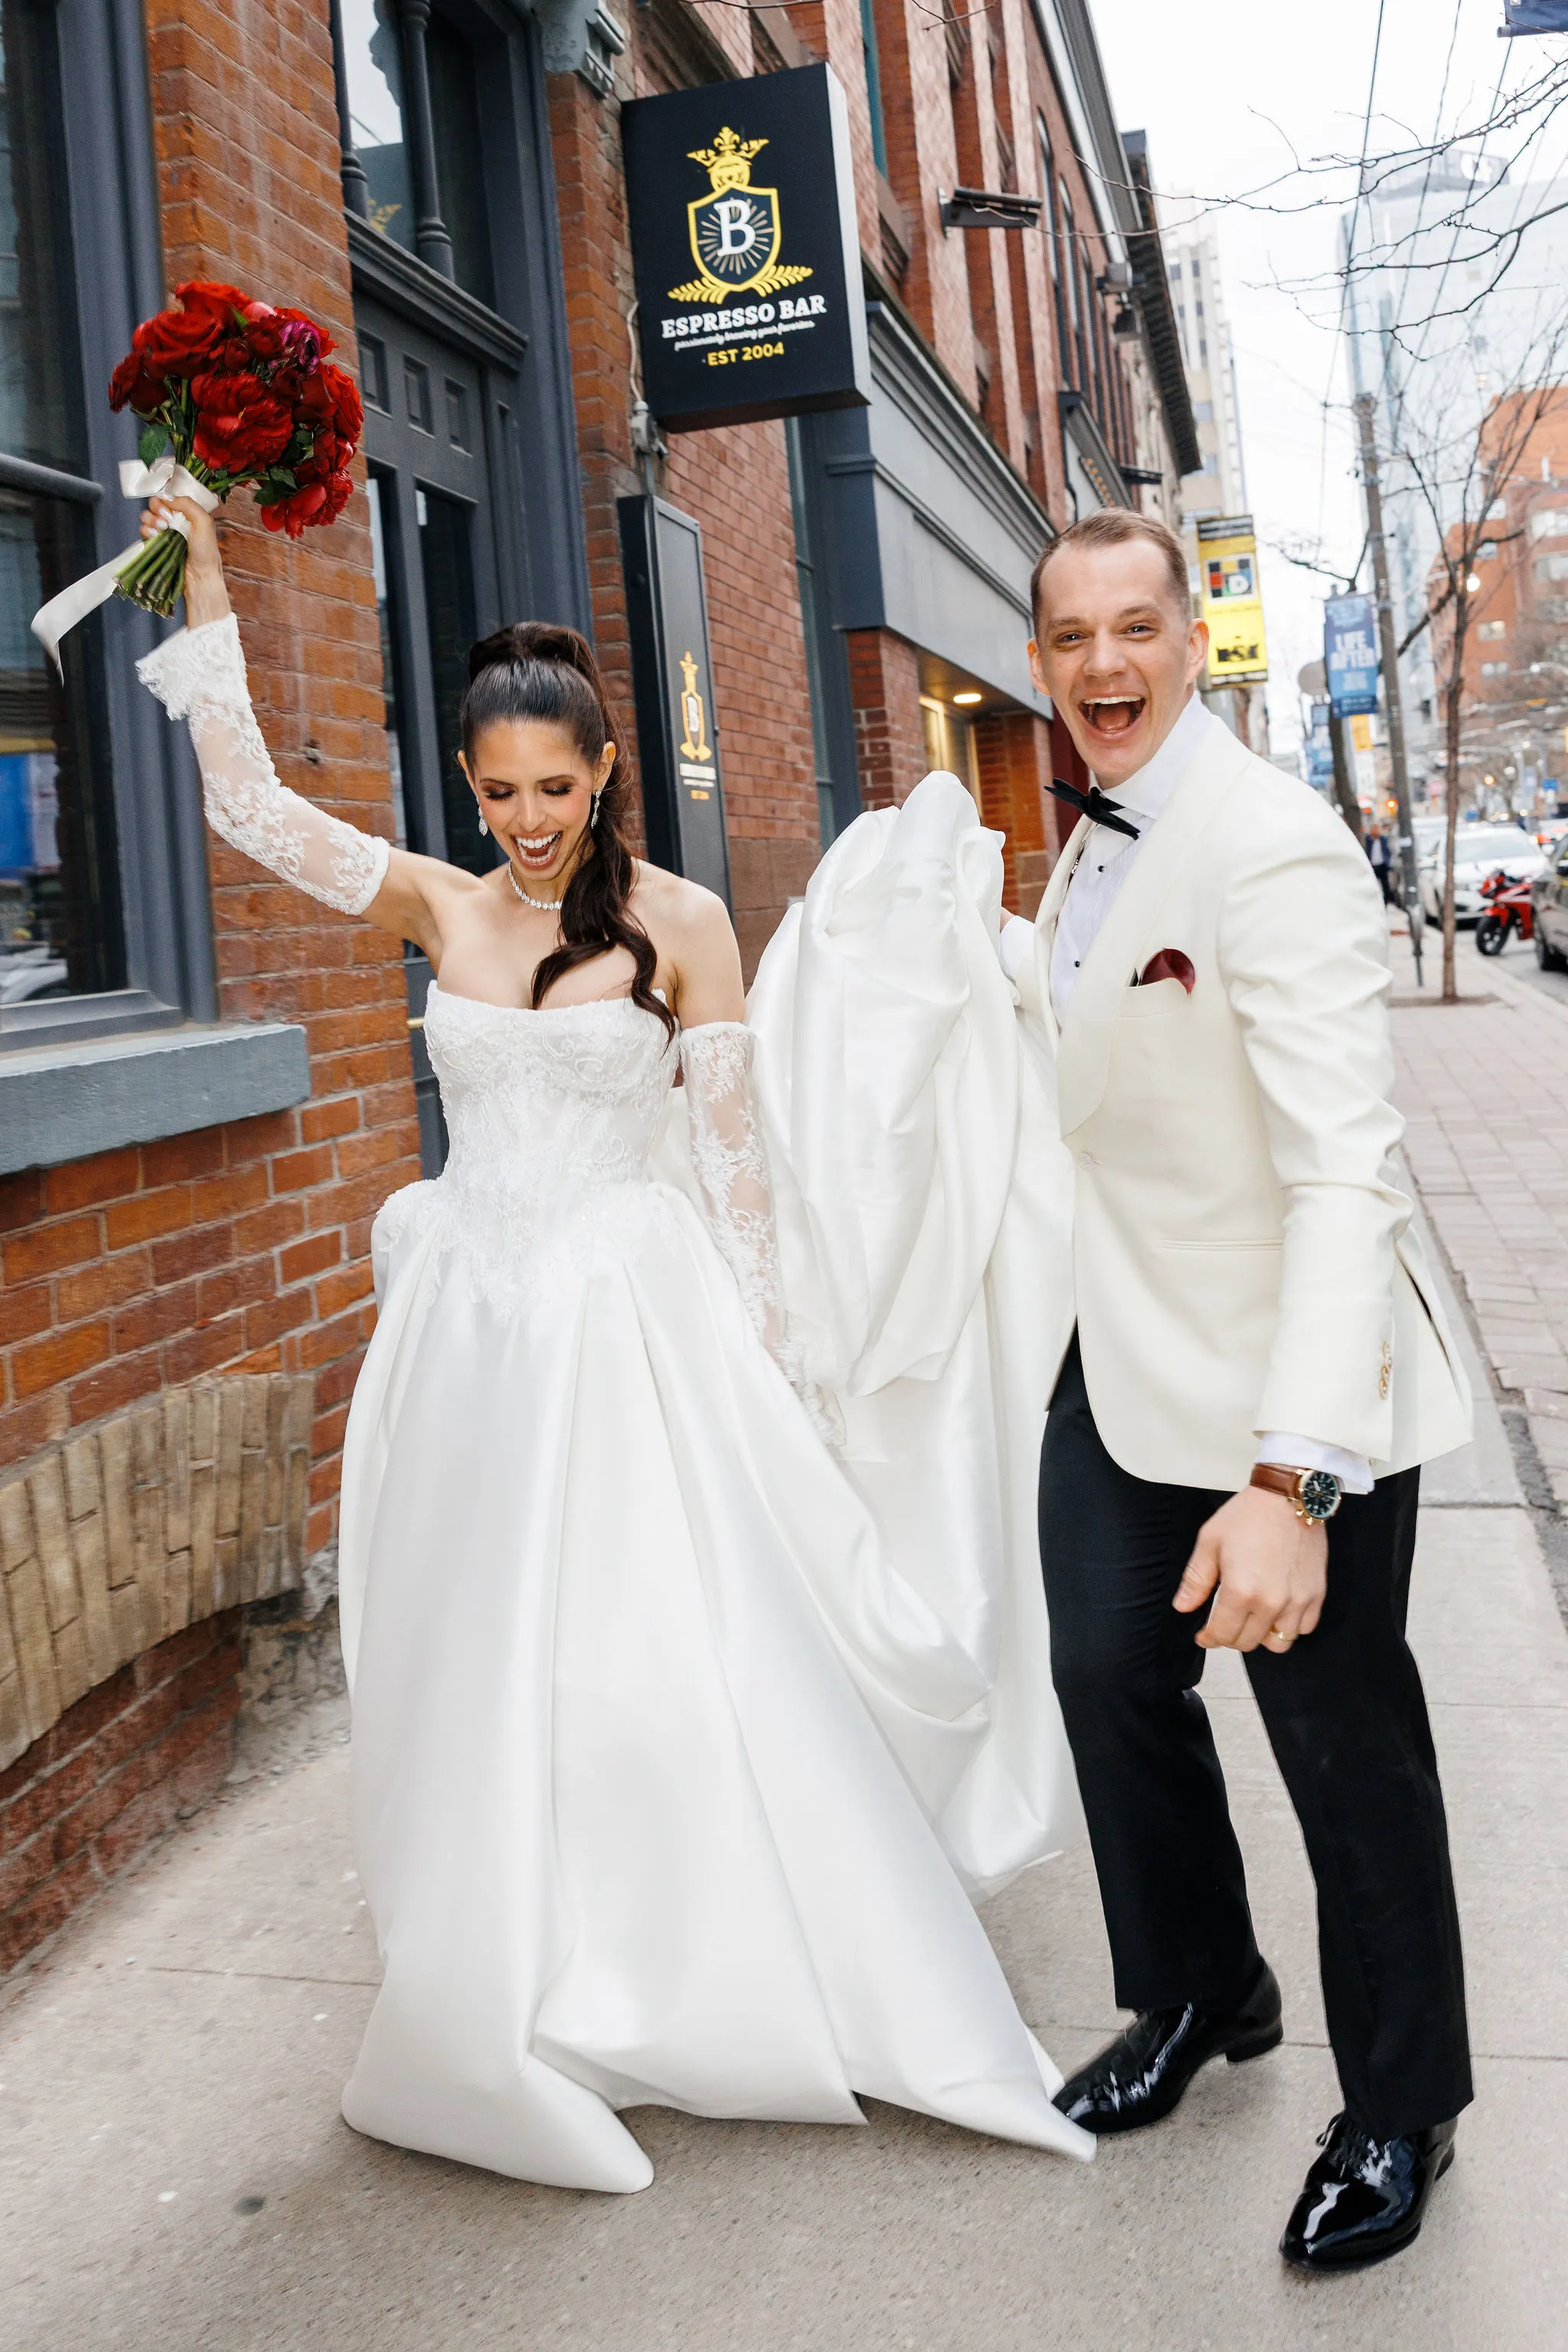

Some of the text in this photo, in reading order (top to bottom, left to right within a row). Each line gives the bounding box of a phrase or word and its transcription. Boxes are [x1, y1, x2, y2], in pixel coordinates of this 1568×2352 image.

[714, 198, 756, 258] B
[661, 294, 827, 338] ESPRESSO BAR
[707, 341, 785, 367] EST 2004
[1331, 648, 1374, 671] AFTER
